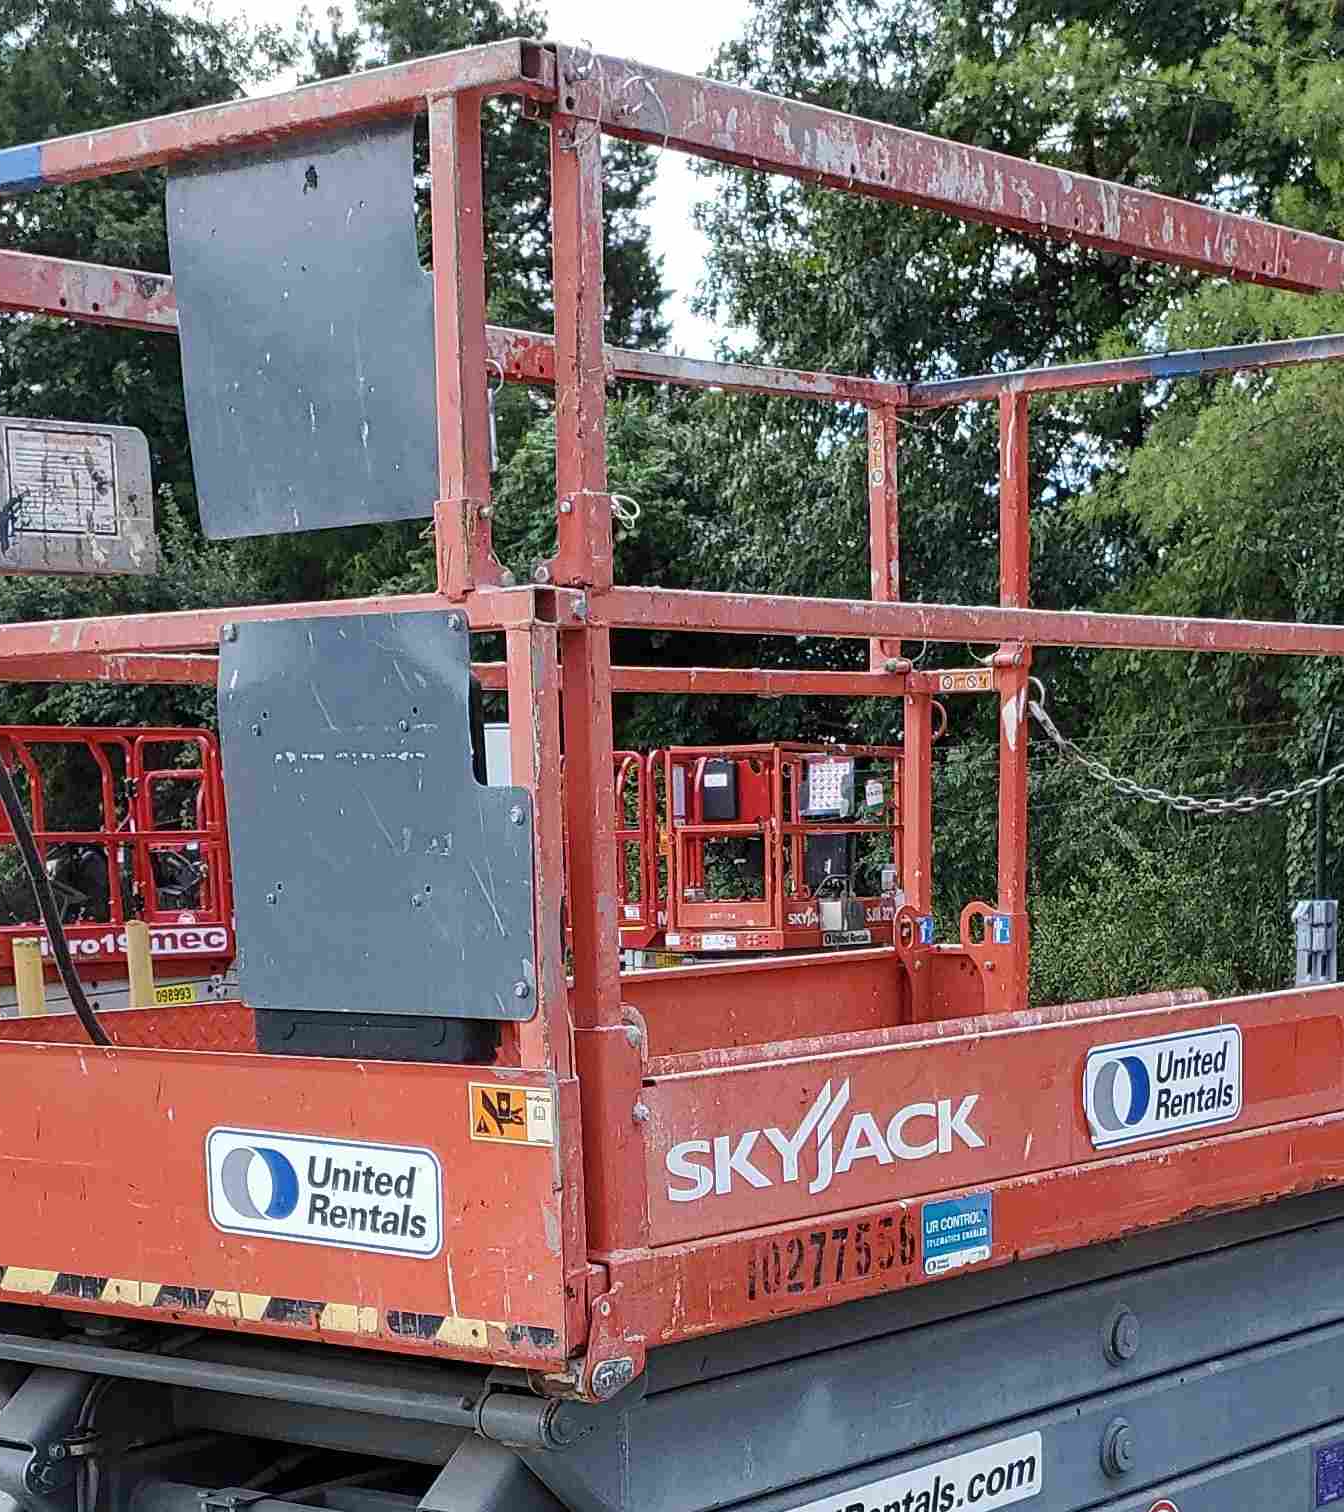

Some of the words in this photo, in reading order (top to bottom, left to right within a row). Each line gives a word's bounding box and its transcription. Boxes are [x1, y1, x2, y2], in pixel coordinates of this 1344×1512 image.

[1155, 1032, 1229, 1085] United
[1155, 1078, 1234, 1121] Rentals
[664, 1075, 986, 1203] SKYJACK
[307, 1155, 418, 1199] United
[307, 1193, 428, 1239] Rentals
